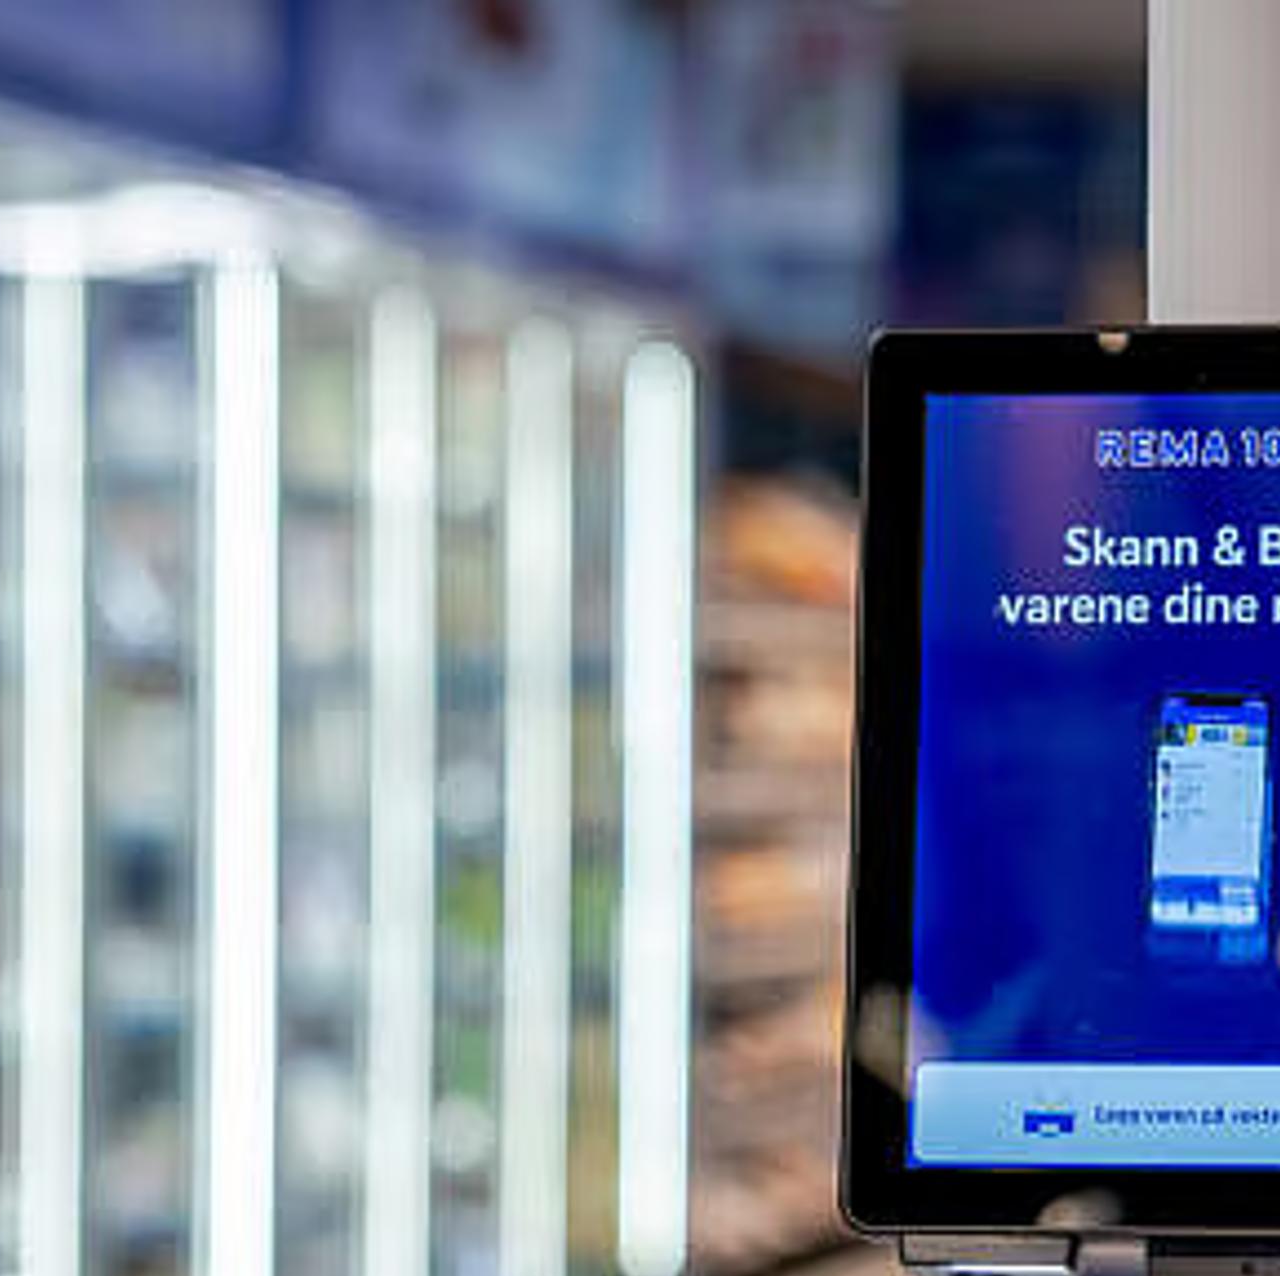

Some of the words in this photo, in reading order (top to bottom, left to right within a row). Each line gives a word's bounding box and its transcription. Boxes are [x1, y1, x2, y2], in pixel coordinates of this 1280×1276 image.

[1096, 429, 1231, 468] REMA
[1063, 525, 1200, 567] Skann
[1213, 527, 1245, 567] &
[999, 590, 1151, 625] varene
[1163, 584, 1260, 625] dine
